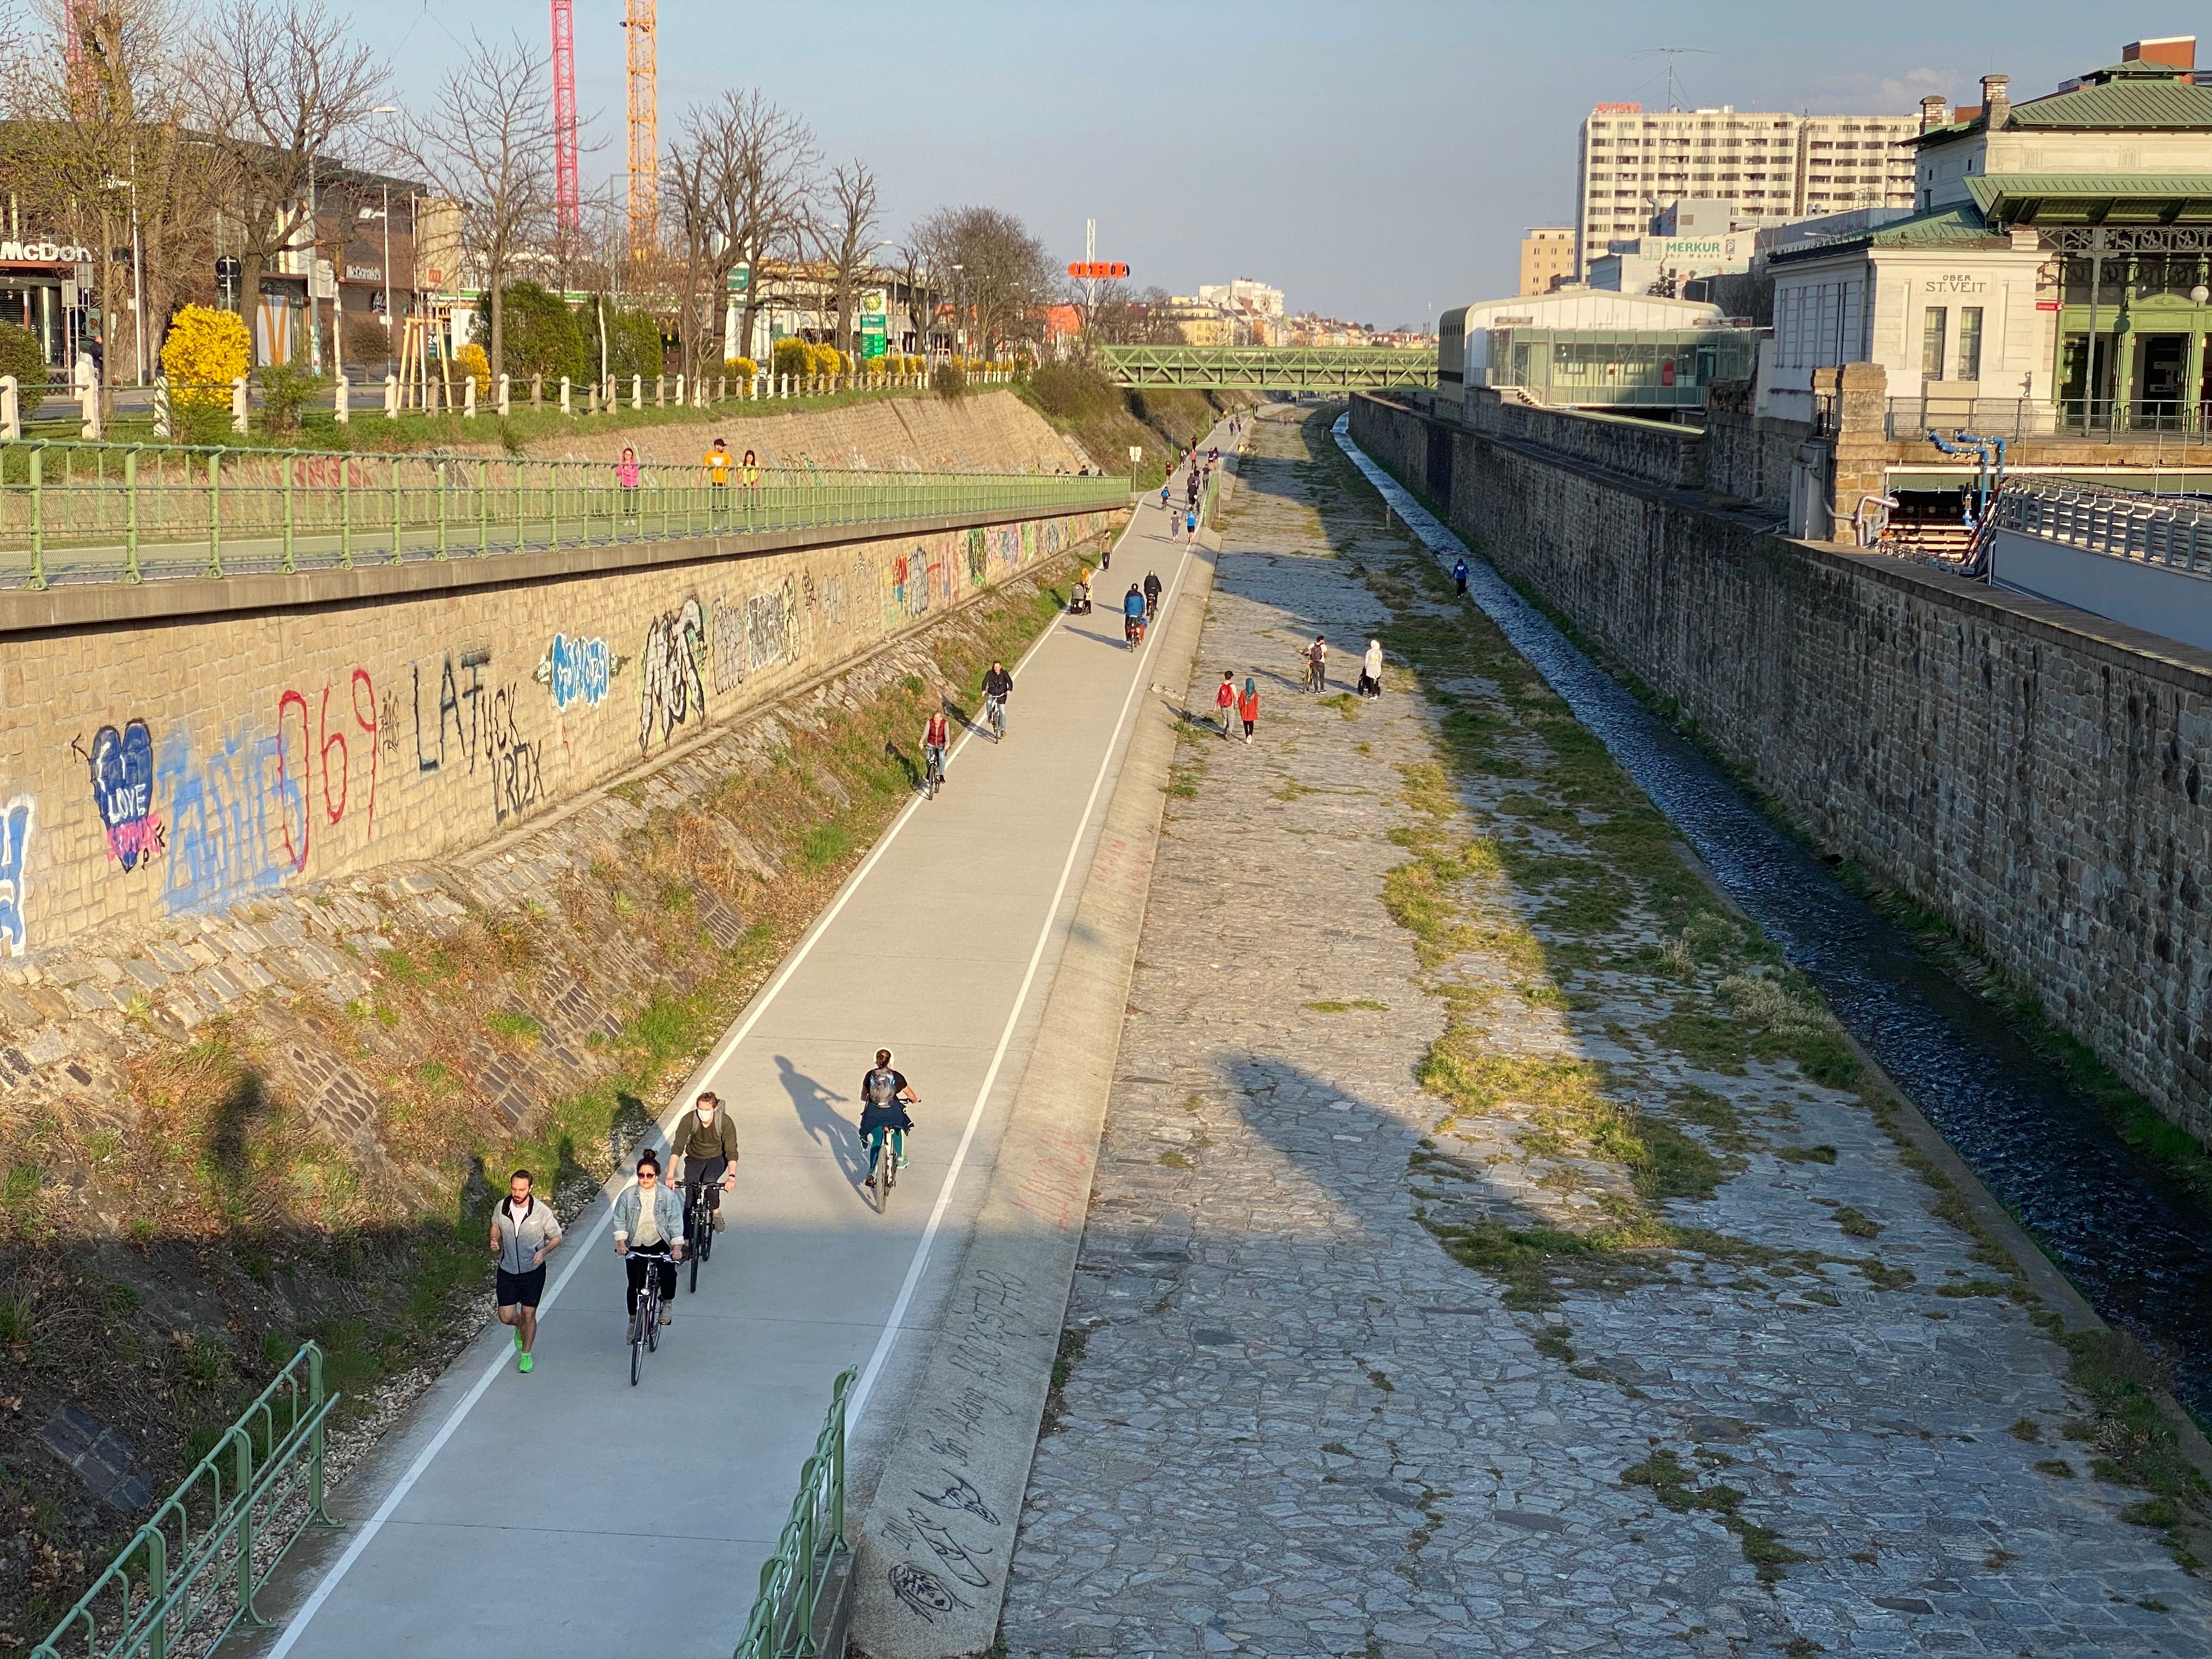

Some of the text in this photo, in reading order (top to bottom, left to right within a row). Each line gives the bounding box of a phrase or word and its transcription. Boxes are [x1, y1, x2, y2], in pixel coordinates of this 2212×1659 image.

[0, 241, 100, 262] McDon
[1666, 242, 1720, 252] MERKUR
[346, 265, 381, 281] McDonald's
[278, 667, 377, 873] 069
[107, 783, 146, 823] LOVE
